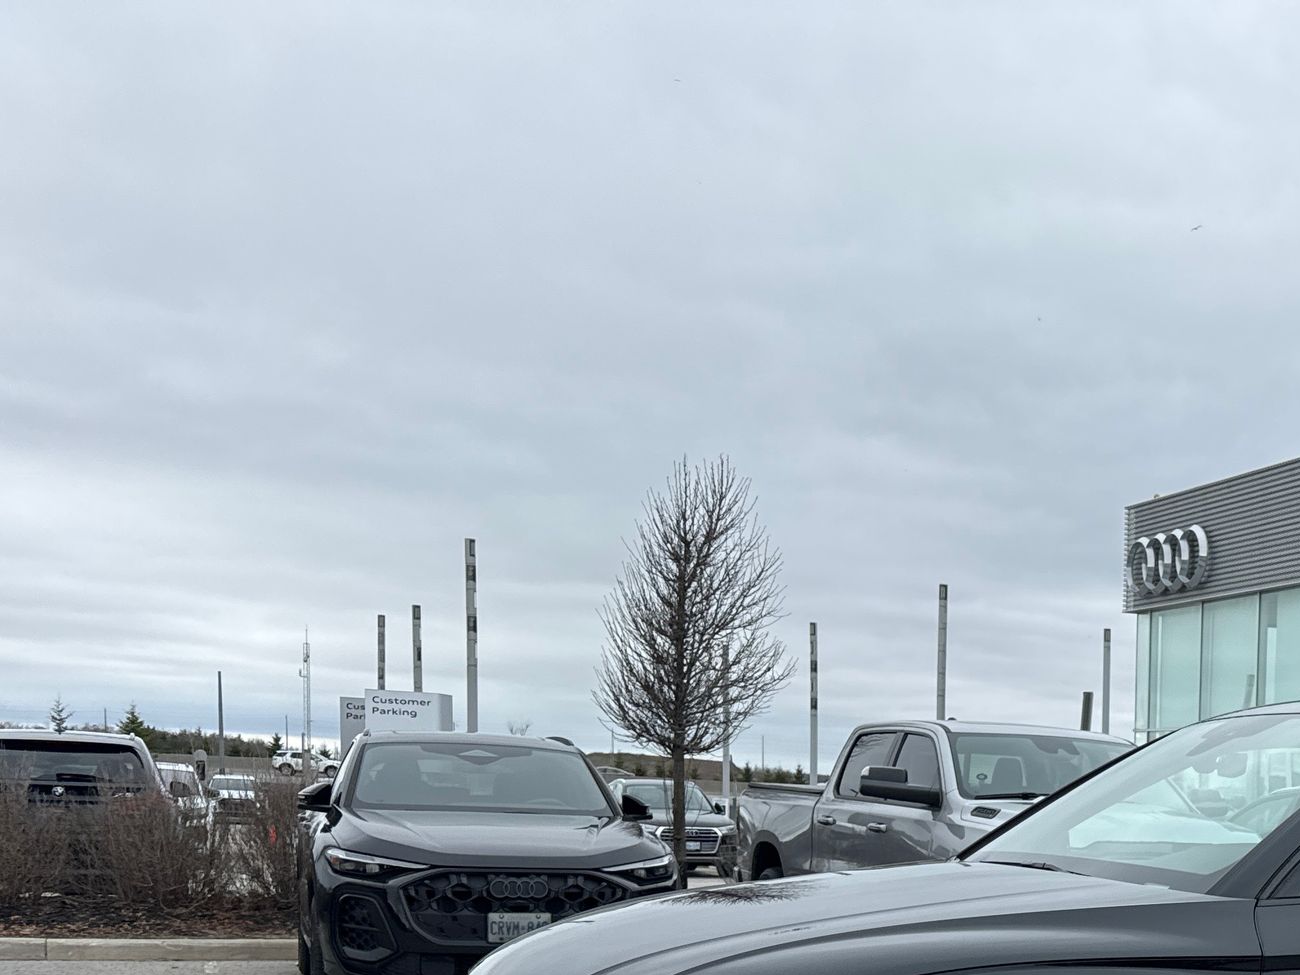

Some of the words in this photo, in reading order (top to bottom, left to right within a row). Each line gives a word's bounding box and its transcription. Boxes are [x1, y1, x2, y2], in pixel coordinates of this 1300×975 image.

[371, 695, 432, 707] Customer
[346, 712, 366, 720] Par
[371, 706, 418, 719] Parking
